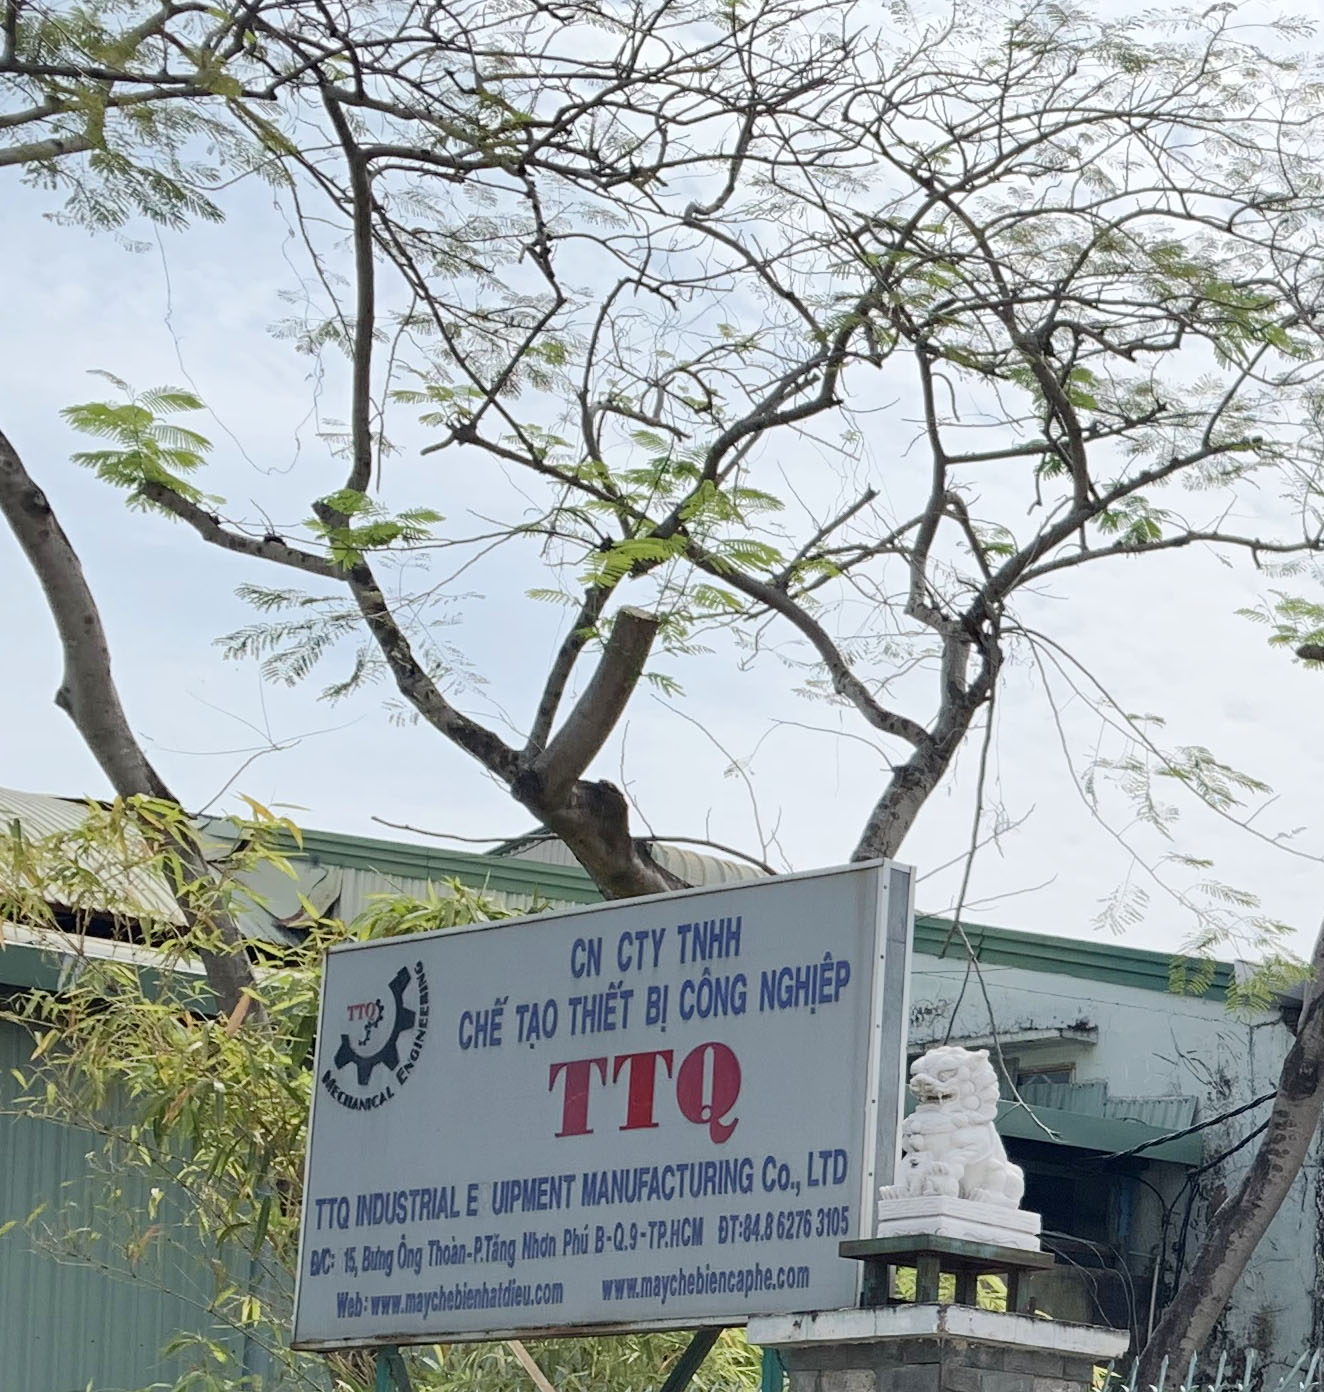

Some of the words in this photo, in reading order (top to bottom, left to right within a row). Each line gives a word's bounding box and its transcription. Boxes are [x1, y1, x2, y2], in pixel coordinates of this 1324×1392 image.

[571, 937, 602, 978] CN
[617, 928, 666, 972] CTY
[677, 916, 742, 964] TNHH
[321, 1069, 395, 1111] MECHANICAL
[395, 960, 430, 1086] ENGINEERING
[347, 1001, 377, 1022] TTQ
[459, 995, 509, 1050] CHẾ
[516, 998, 558, 1050] TẠO
[568, 980, 634, 1036] THIẾT
[646, 984, 668, 1032] BỊ
[679, 966, 748, 1021] CÔNG
[759, 951, 850, 1014] NGHIỆP
[548, 1041, 742, 1144] TTQ
[315, 1196, 350, 1230] TTQ
[355, 1185, 460, 1227] INDUSTRIAL
[466, 1174, 577, 1216] EUIPMENT
[581, 1157, 754, 1207] MANUFACTURING
[762, 1155, 801, 1197] Co.,
[807, 1148, 848, 1187] LTD
[397, 1233, 422, 1275] Ông
[562, 1224, 588, 1256] Phú
[777, 1208, 812, 1240] 6276
[816, 1205, 849, 1238] 3105
[602, 1262, 810, 1305] www.maychebiencaphe.com
